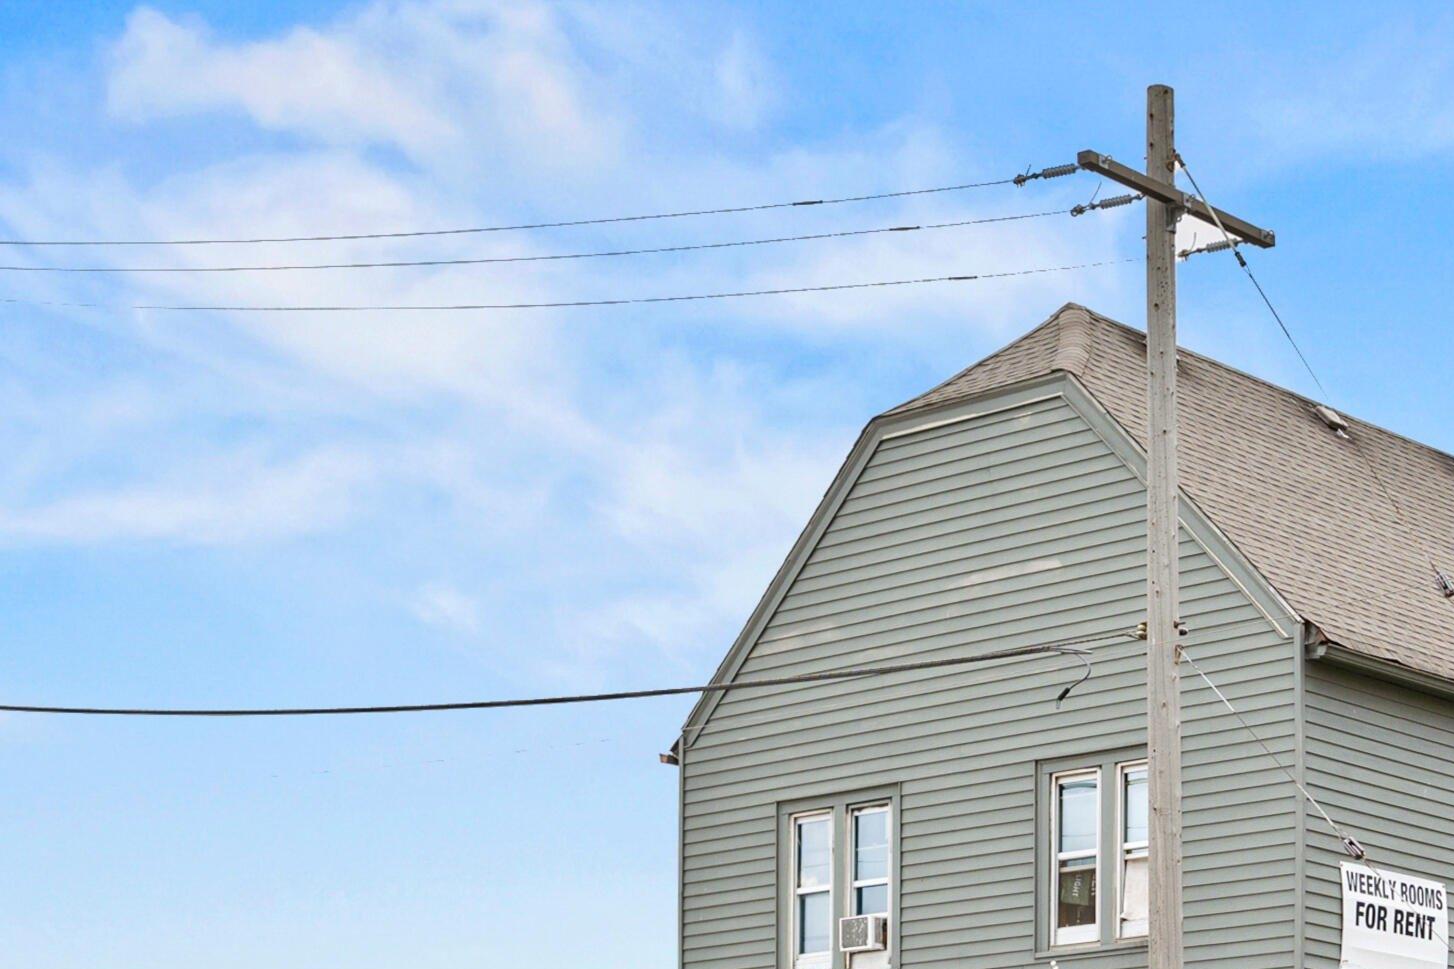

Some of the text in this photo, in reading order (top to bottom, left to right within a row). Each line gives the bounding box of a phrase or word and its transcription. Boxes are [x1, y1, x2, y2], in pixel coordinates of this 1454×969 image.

[1346, 870, 1443, 911] WEEKLY ROOMS
[1355, 901, 1436, 940] FOR RENT
